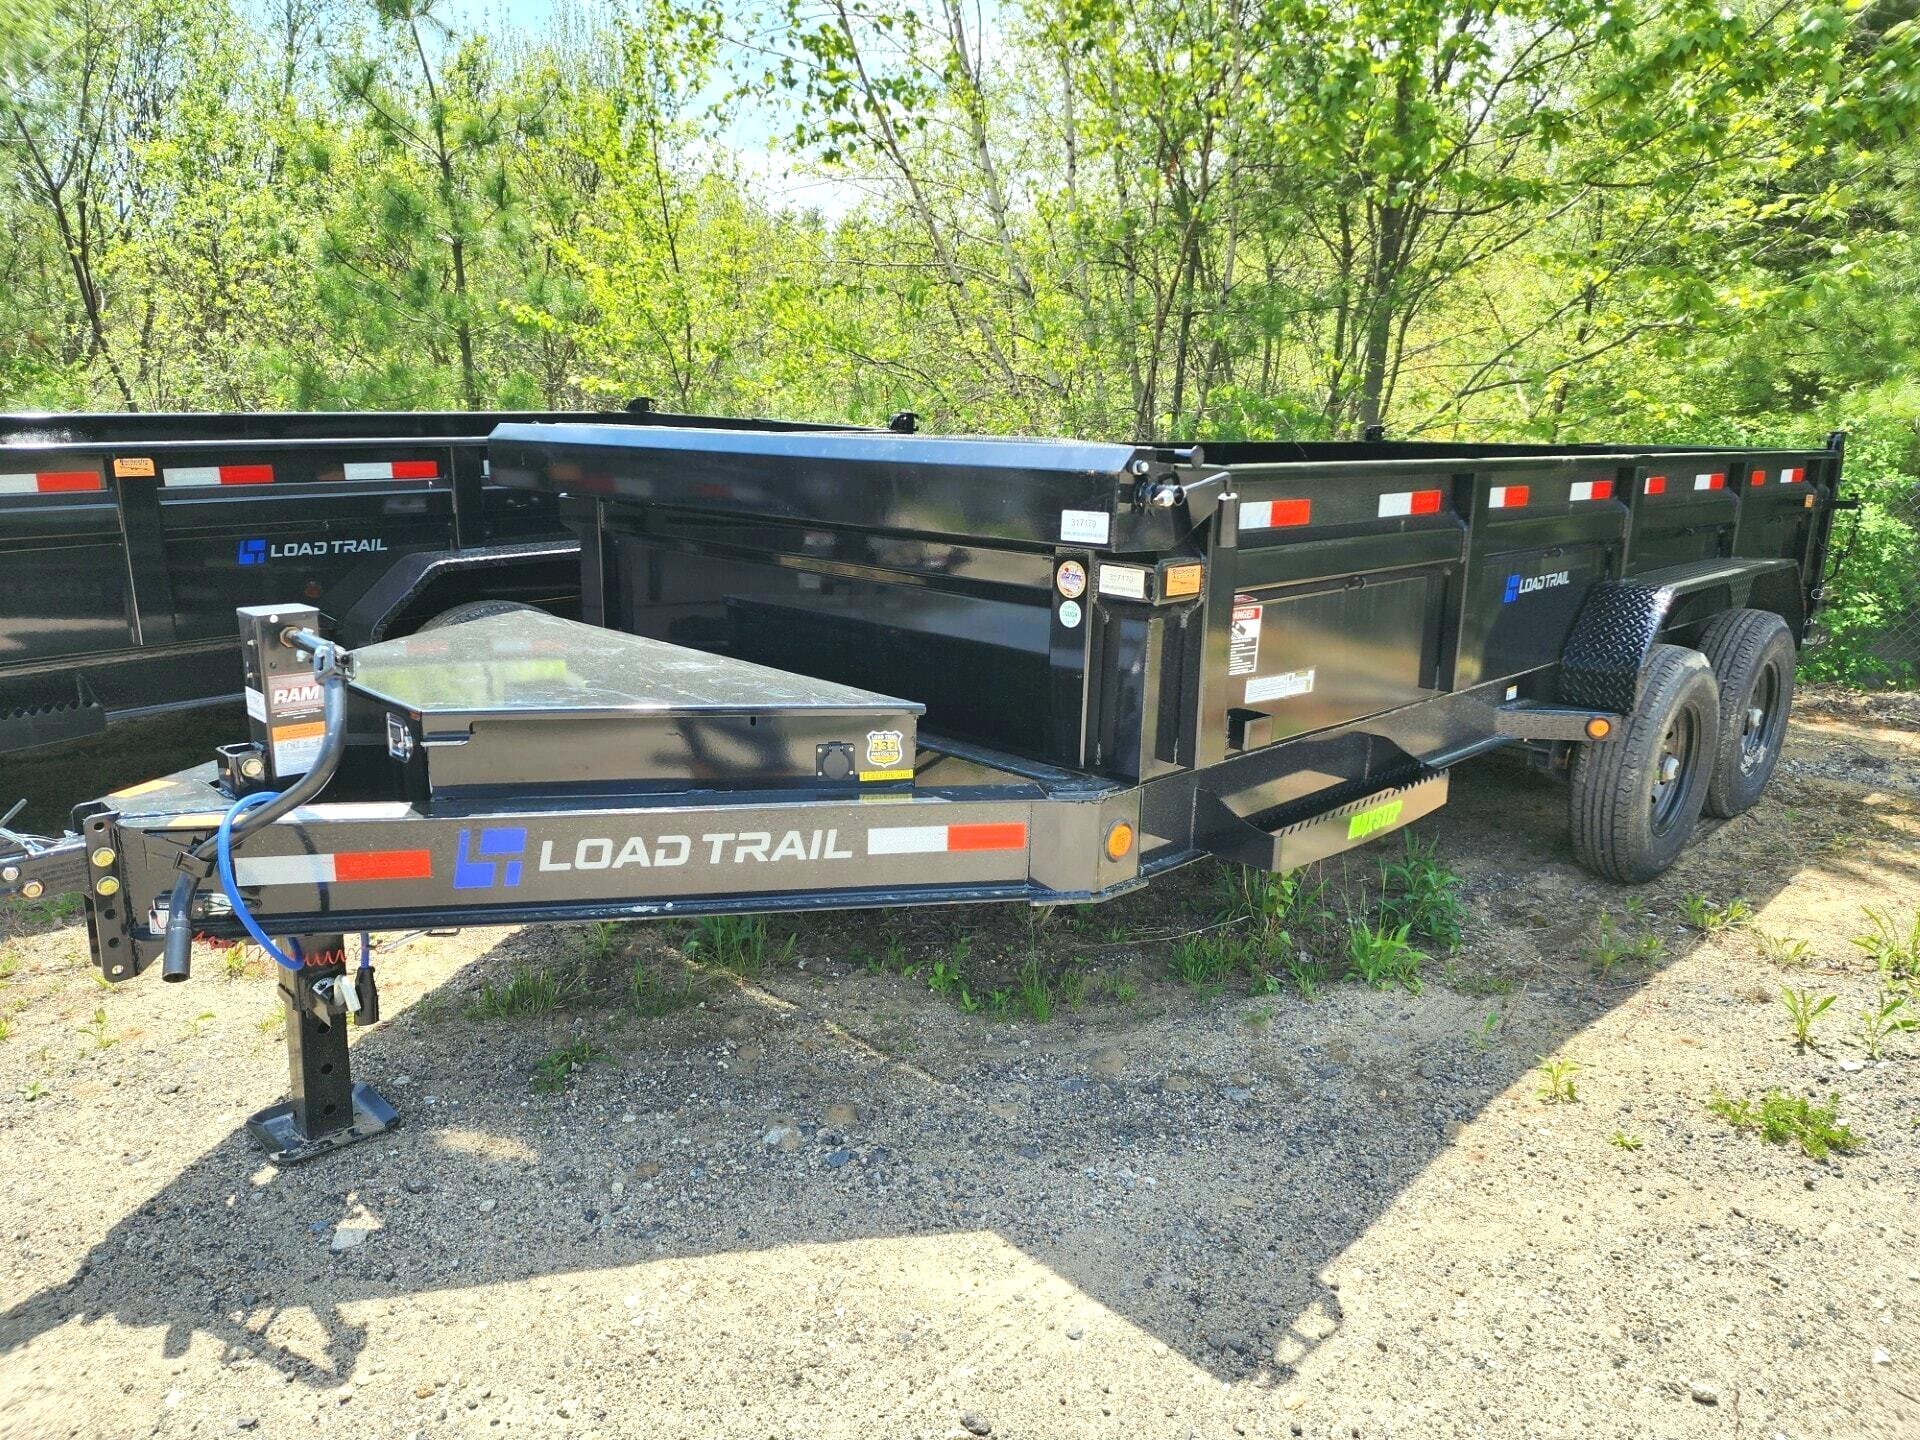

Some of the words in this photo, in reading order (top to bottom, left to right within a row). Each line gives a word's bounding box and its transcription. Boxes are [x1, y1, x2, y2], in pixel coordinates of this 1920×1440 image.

[270, 542, 328, 558] LOAD
[331, 538, 388, 554] TRAIL
[1518, 575, 1546, 594] LOAD
[1545, 570, 1570, 588] TRAIL
[1232, 609, 1255, 620] ANGER
[273, 685, 321, 705] RAM
[539, 836, 690, 873] LOAD
[702, 829, 852, 864] TRAIL
